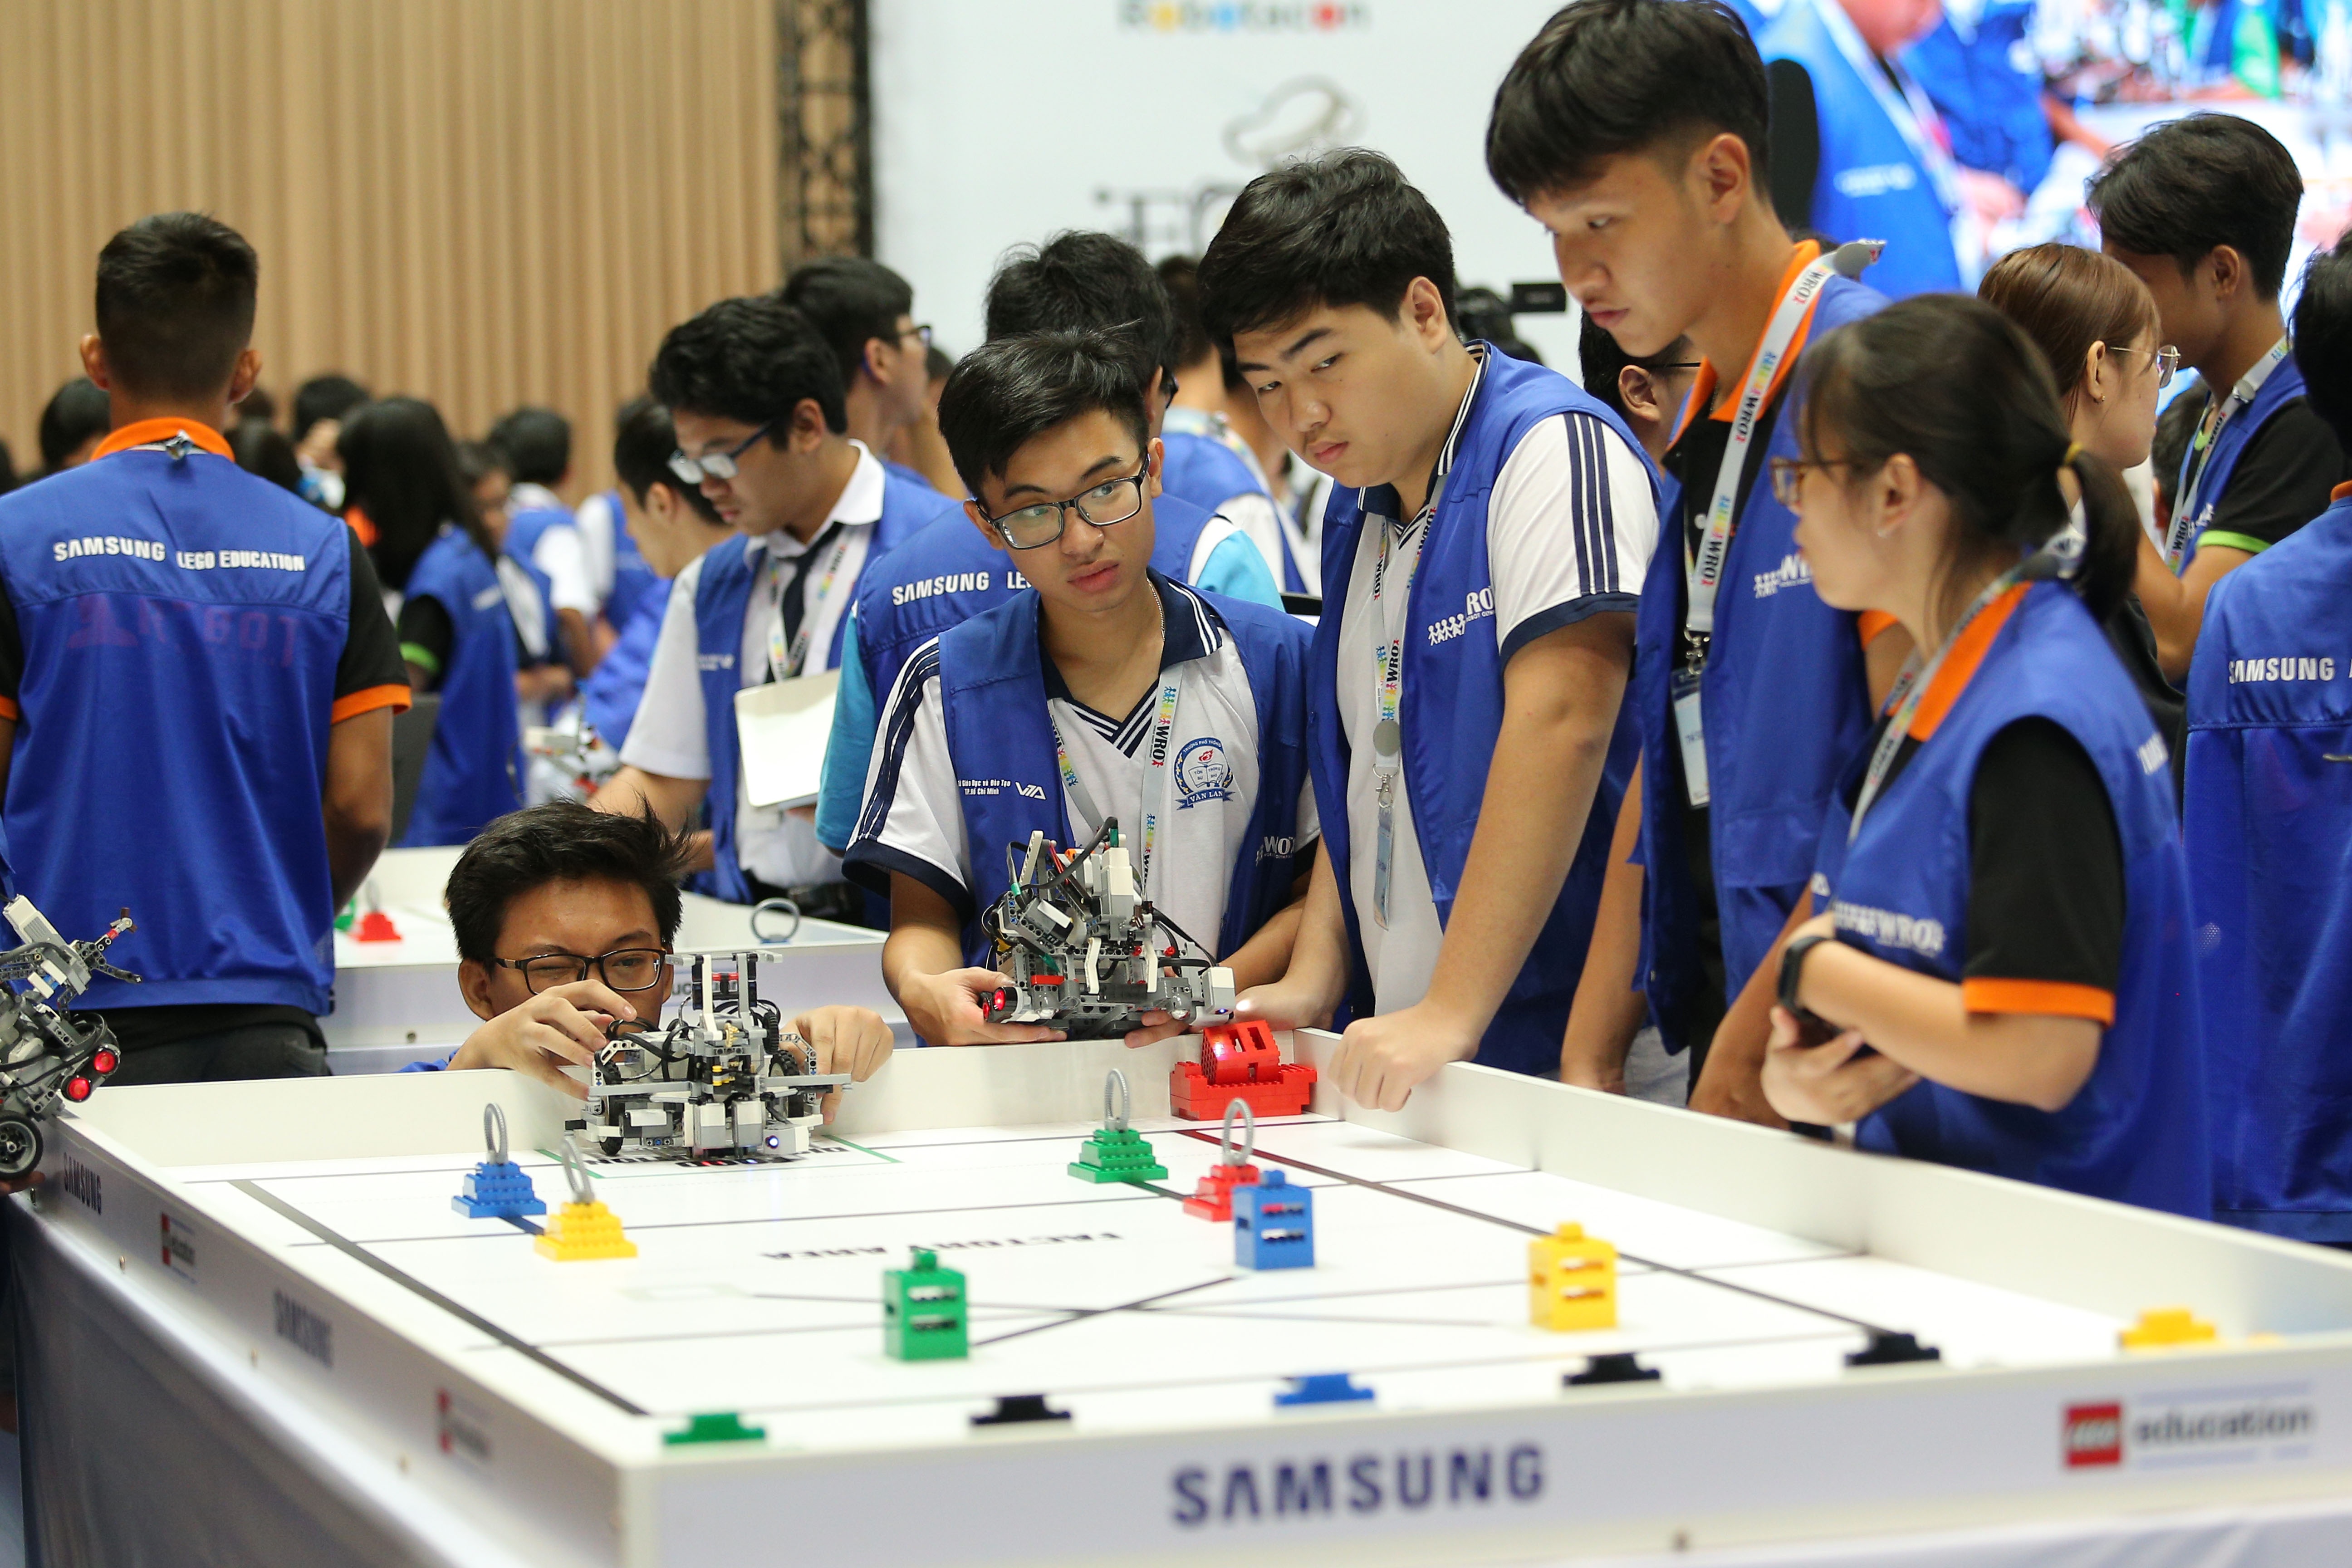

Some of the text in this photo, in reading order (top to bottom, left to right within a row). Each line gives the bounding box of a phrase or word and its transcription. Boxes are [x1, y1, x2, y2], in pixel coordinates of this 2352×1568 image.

[54, 536, 305, 571] SAMSUNG LEGO EDUCATION
[1702, 541, 1722, 578] WRO
[892, 571, 990, 606] SAMSUNG
[1387, 646, 1399, 682] WRO
[2229, 657, 2335, 684] SAMSUNG
[1152, 726, 1171, 760] WRO
[64, 1152, 102, 1215] SAMSUNG
[1172, 1445, 1546, 1525] SAMSUNG
